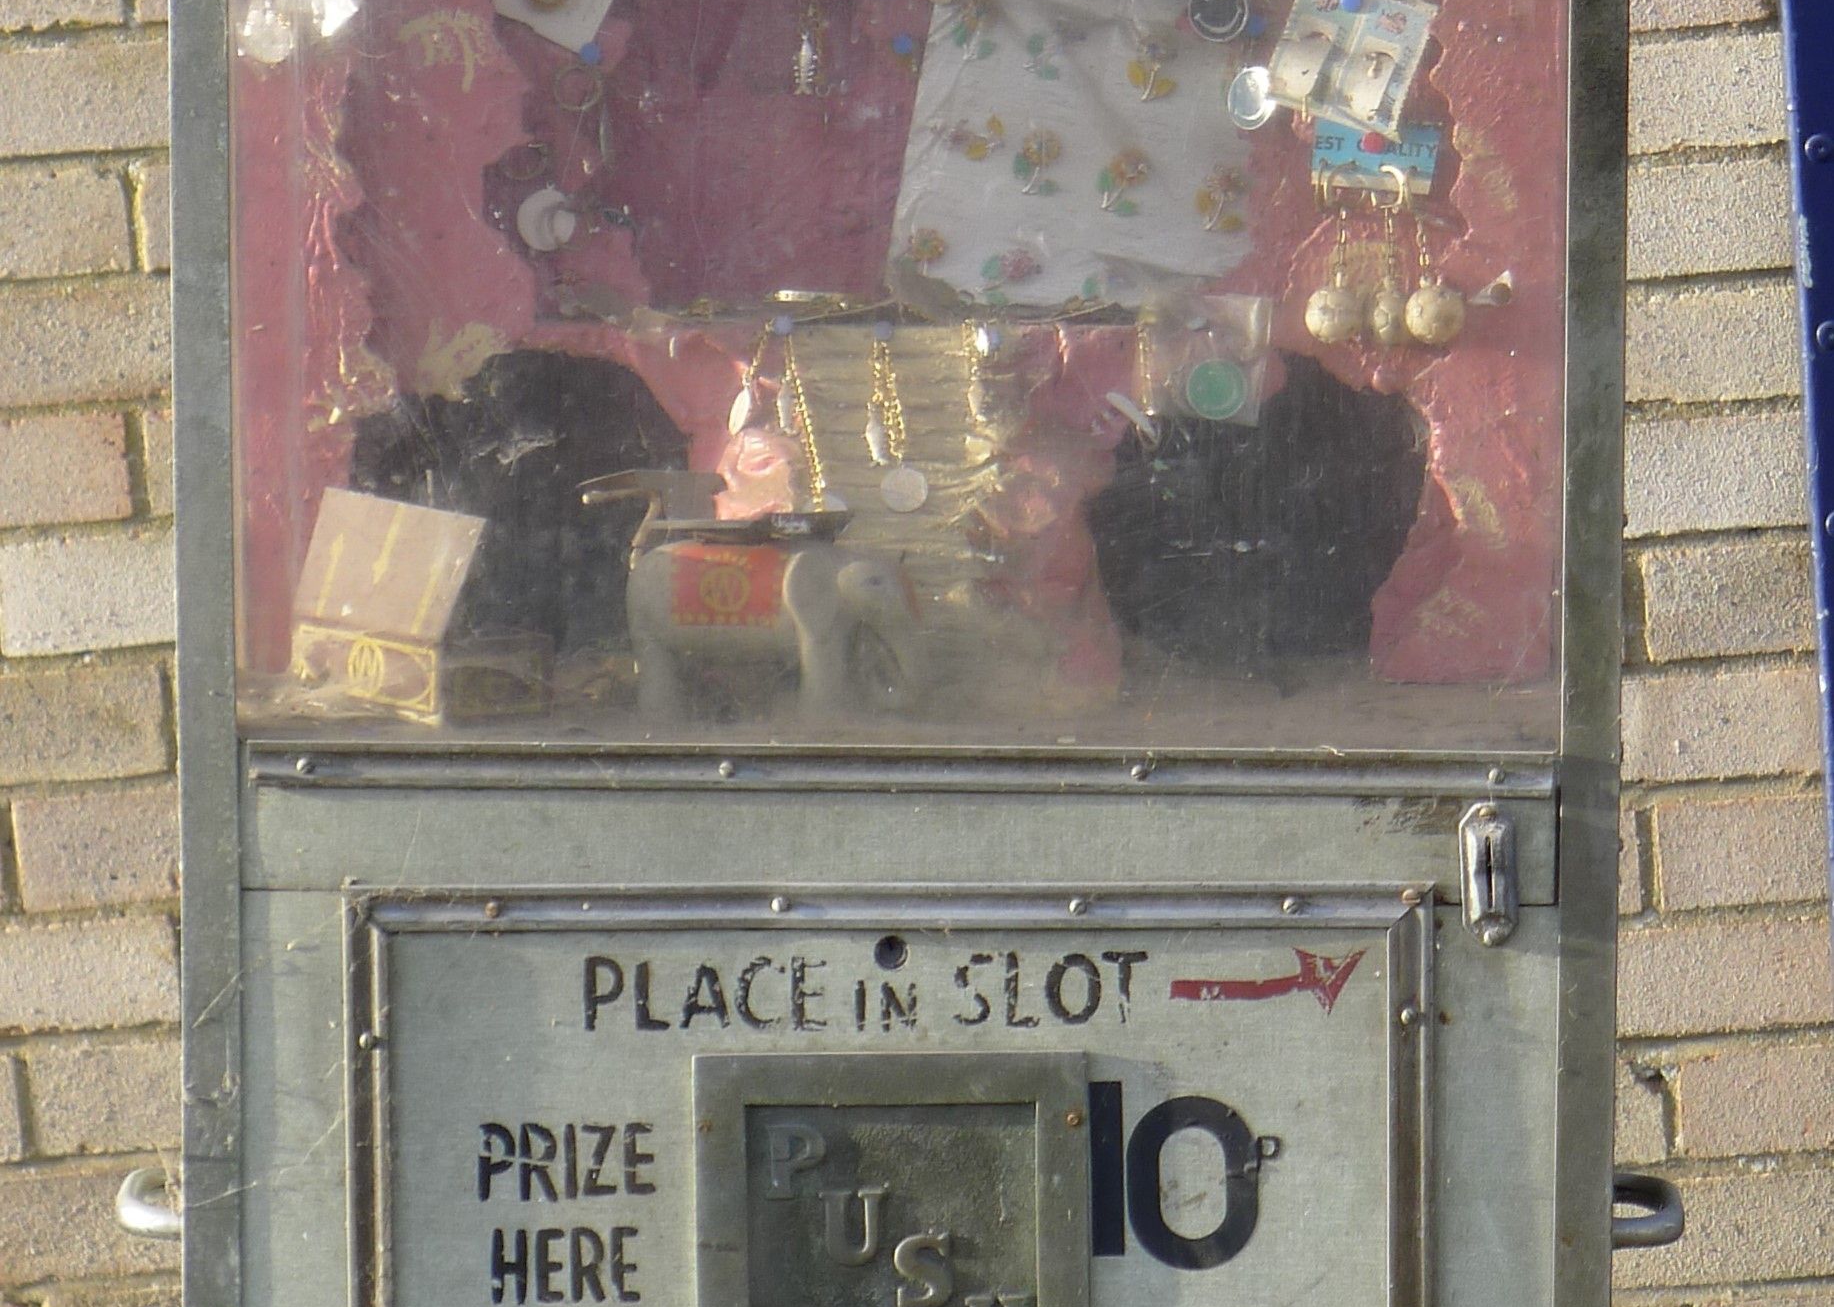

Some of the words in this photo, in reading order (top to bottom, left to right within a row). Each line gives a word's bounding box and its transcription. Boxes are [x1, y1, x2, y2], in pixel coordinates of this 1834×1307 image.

[583, 955, 827, 1032] PLACE
[953, 949, 1149, 1028] SLOT
[477, 1121, 656, 1202] PRIZE
[490, 1225, 642, 1305] HERE
